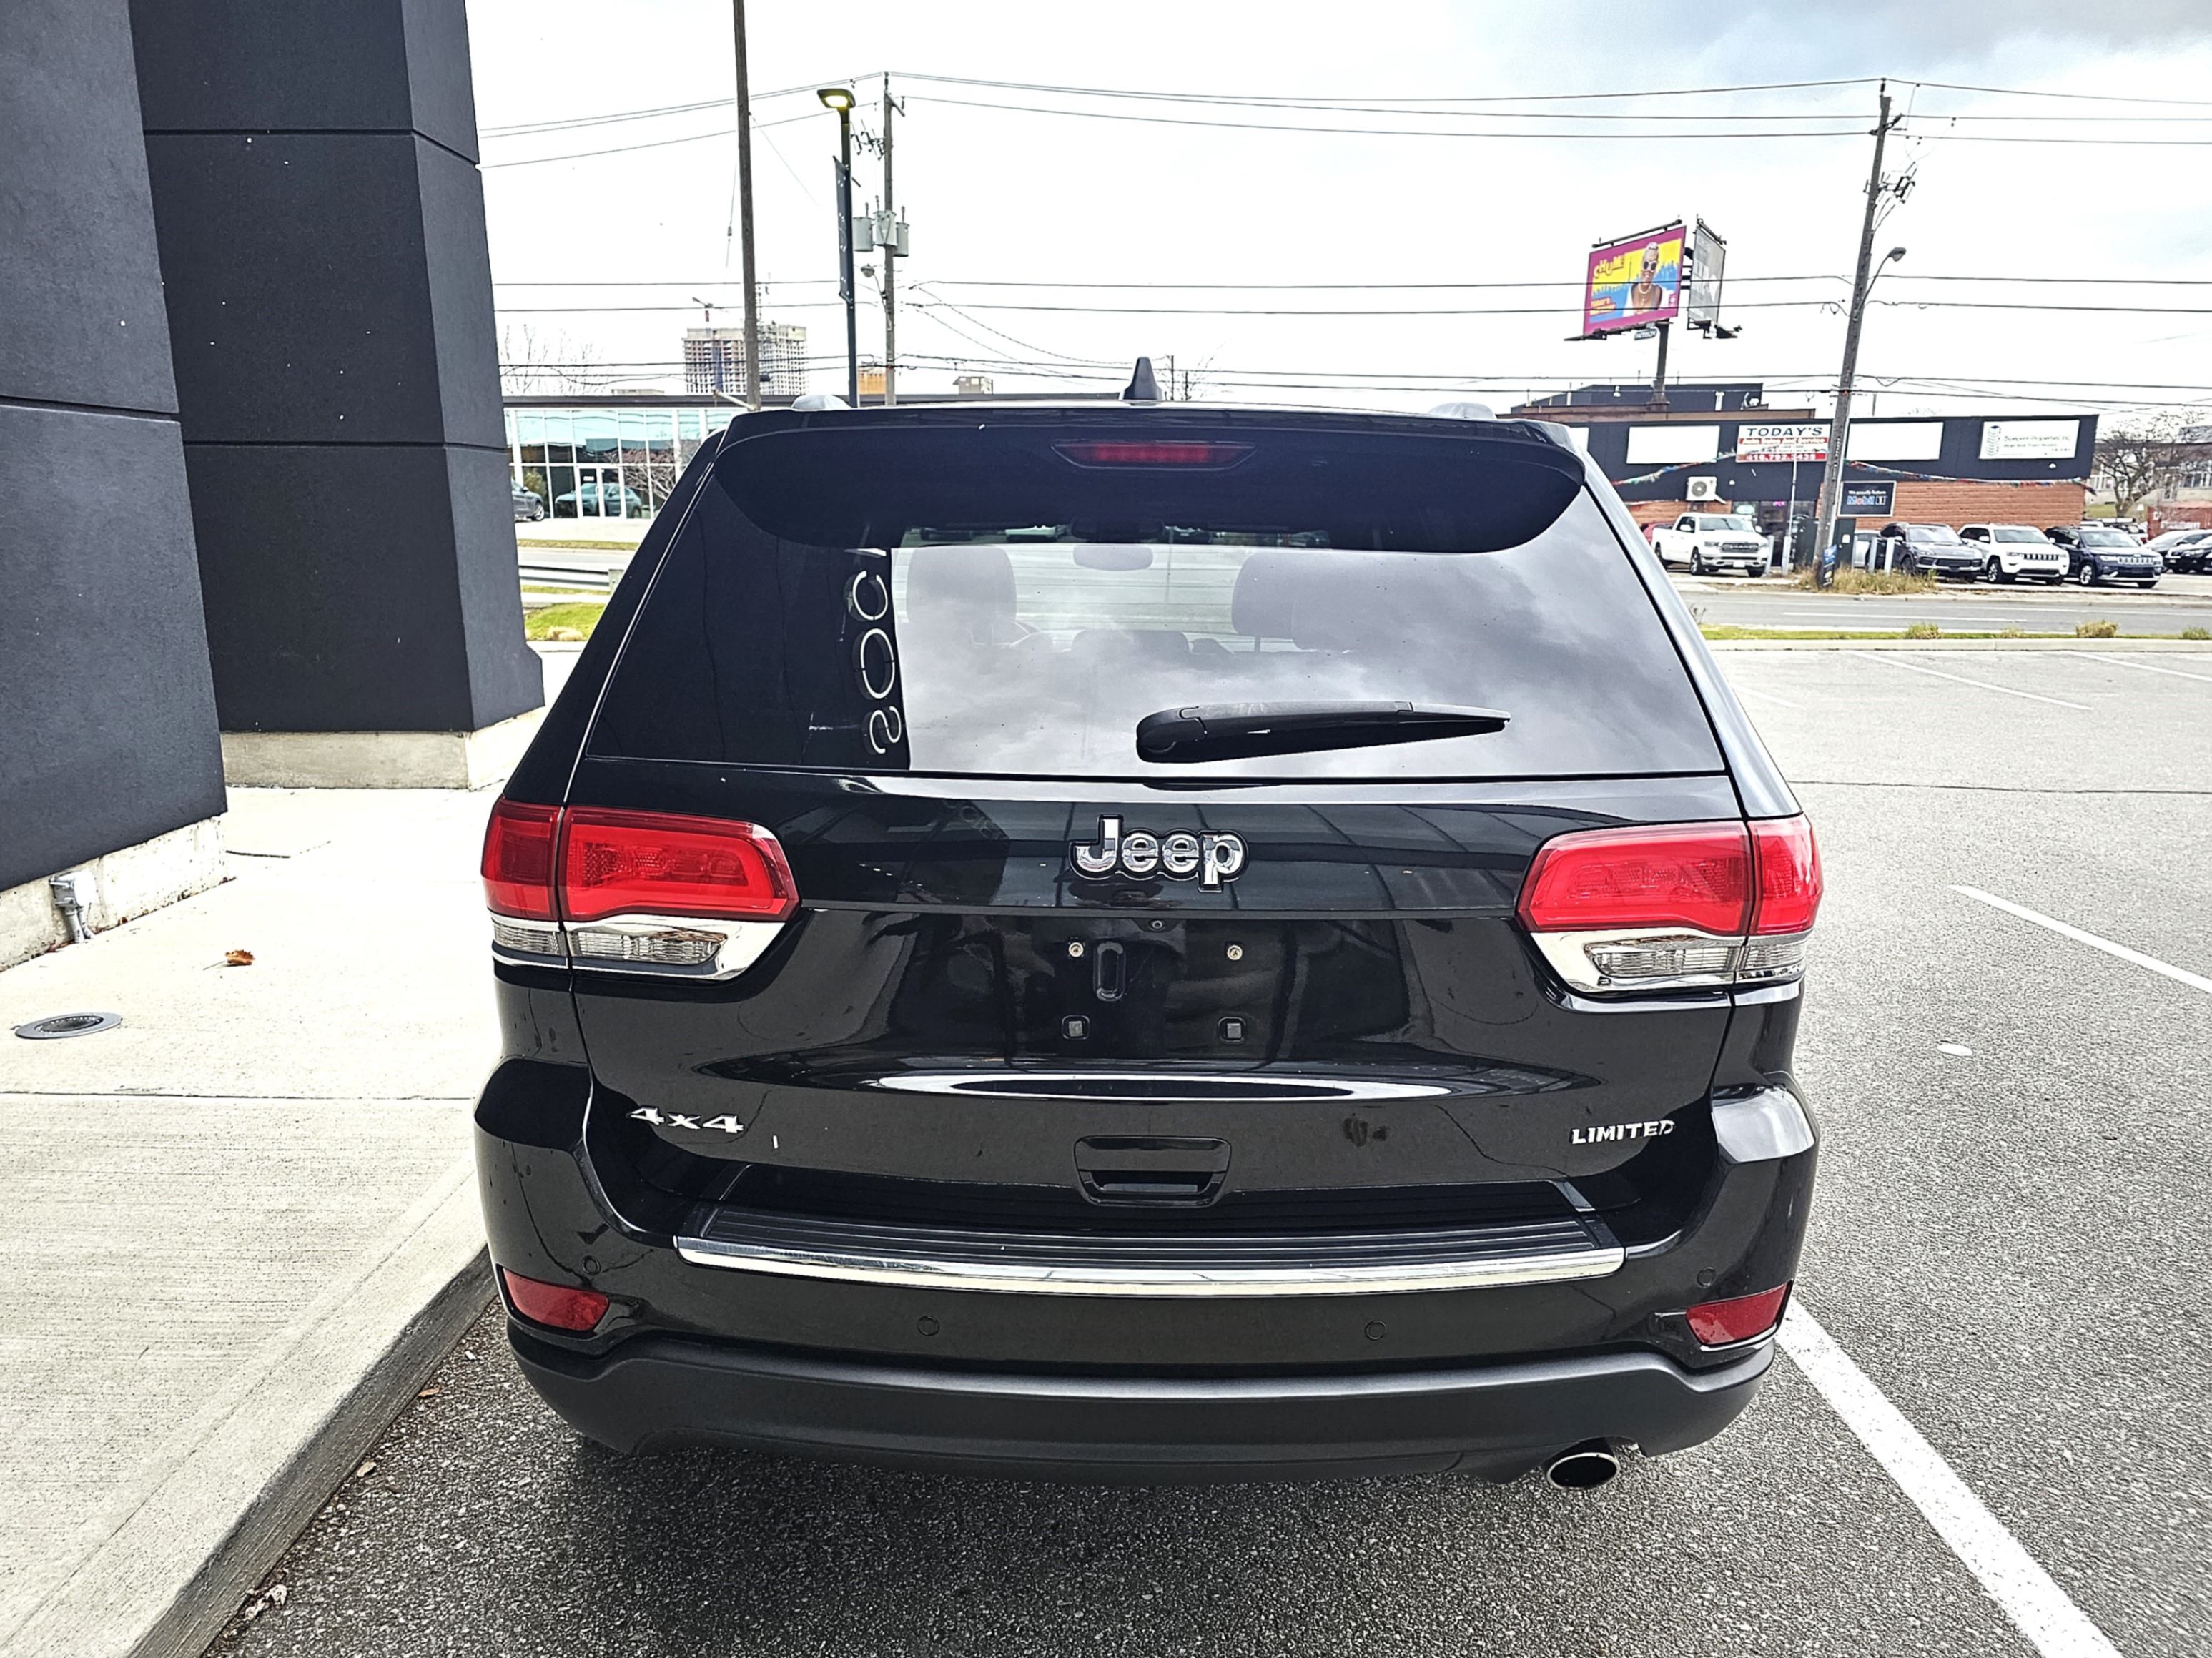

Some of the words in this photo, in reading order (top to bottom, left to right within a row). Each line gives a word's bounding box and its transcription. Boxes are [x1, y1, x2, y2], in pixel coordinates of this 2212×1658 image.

[1747, 427, 1823, 436] TODAY'S
[1847, 495, 1875, 505] Mobil
[1072, 816, 1246, 889] Jeep
[628, 1107, 744, 1133] 4x4
[1571, 1120, 1675, 1144] LIMITED
